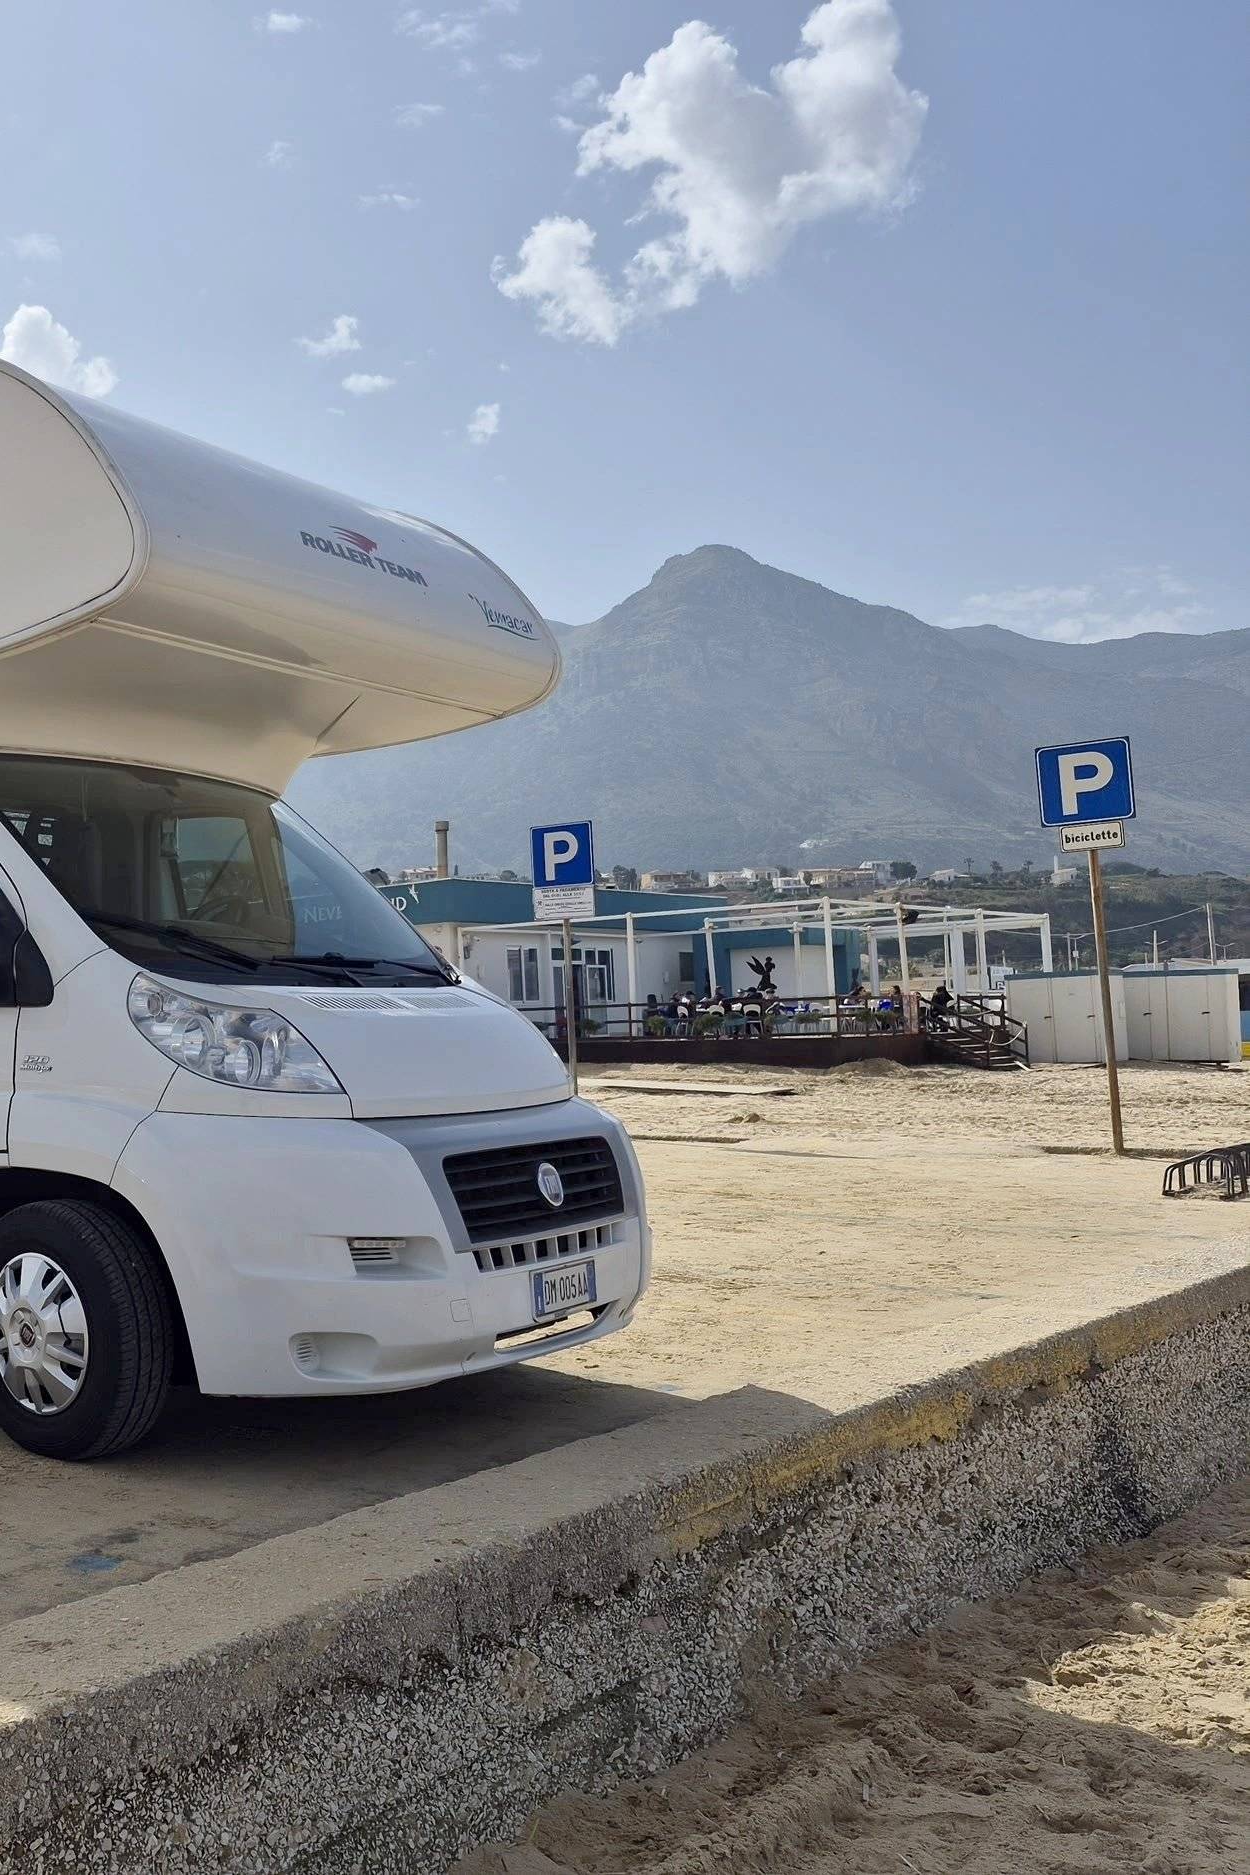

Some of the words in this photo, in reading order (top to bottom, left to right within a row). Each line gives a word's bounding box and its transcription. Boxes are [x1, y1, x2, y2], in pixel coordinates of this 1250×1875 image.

[300, 531, 375, 569] ROLLER
[374, 557, 429, 587] TEAM
[1058, 751, 1114, 816] P
[543, 831, 579, 881] P
[1064, 829, 1119, 844] biciclette
